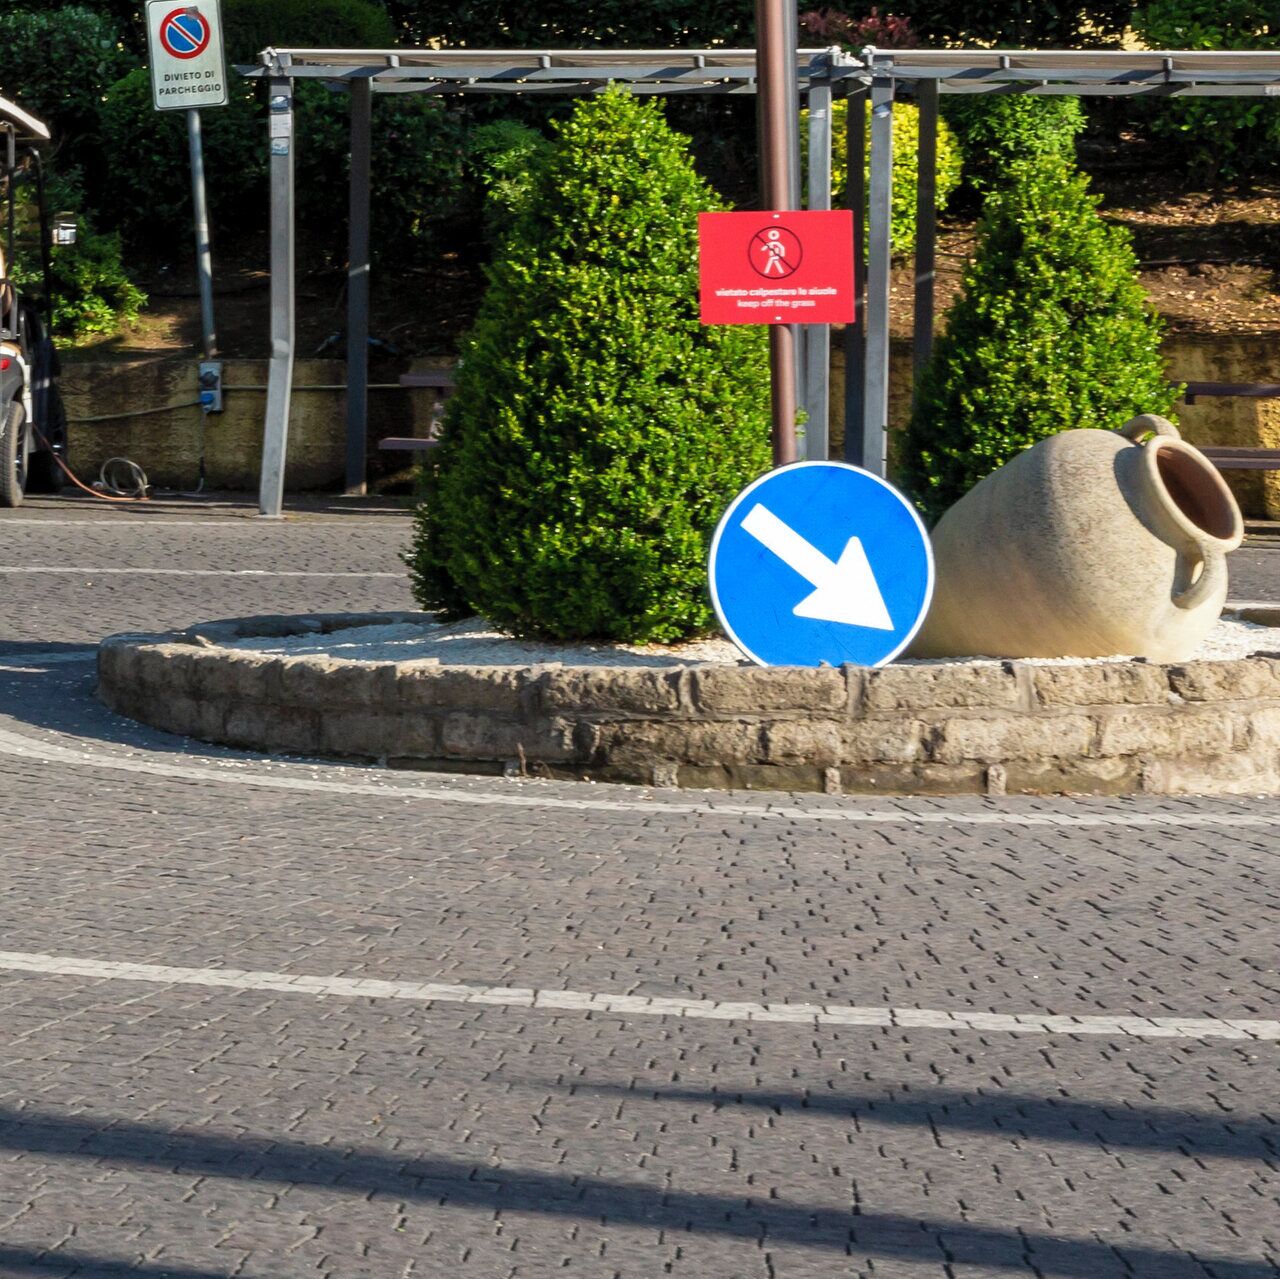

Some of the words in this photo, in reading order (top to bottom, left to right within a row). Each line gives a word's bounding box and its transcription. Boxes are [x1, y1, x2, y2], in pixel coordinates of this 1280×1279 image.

[164, 71, 202, 81] DIVIETO
[205, 70, 215, 79] DI
[159, 84, 222, 96] PARCHEGGIO
